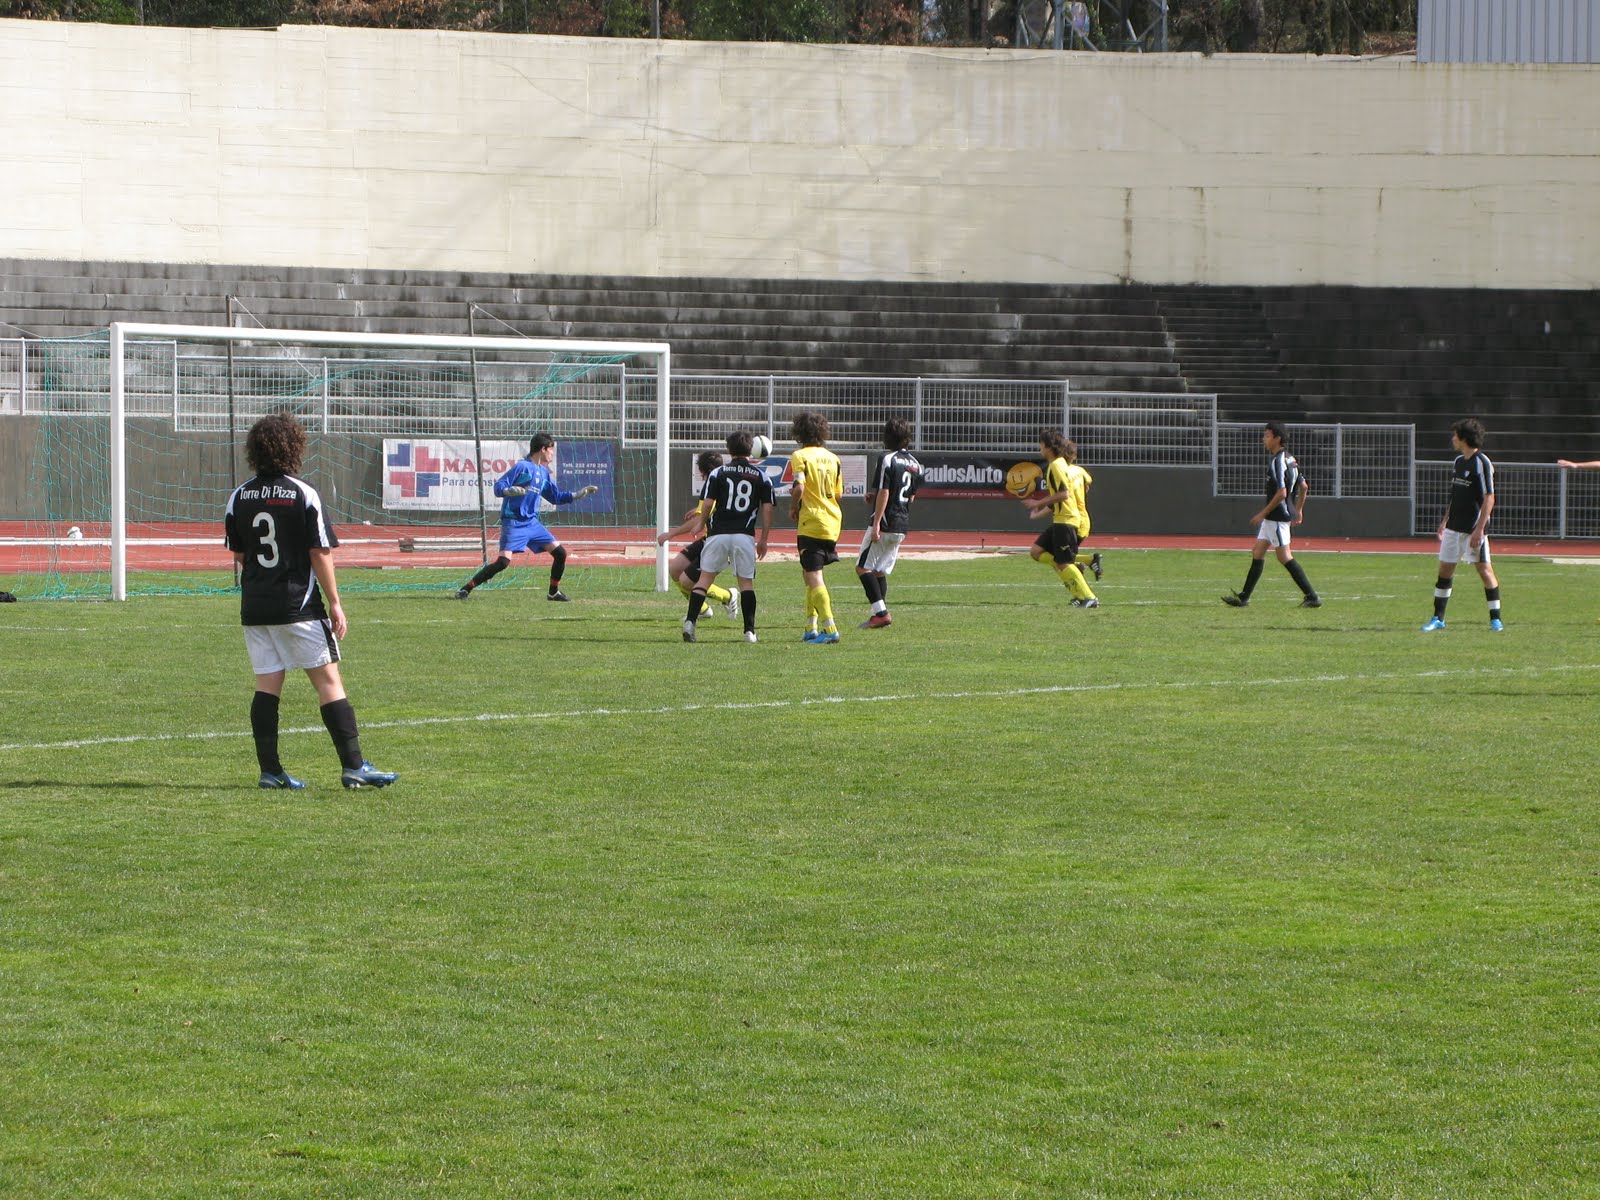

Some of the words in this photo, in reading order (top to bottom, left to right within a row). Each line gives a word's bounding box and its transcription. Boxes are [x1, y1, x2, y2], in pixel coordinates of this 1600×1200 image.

[240, 487, 260, 500] Torre
[261, 486, 271, 499] Di
[272, 485, 297, 500] Pizza
[442, 477, 465, 487] Para
[843, 485, 864, 494] obil
[899, 471, 912, 502] 2
[725, 476, 753, 512] 18
[252, 511, 280, 569] 3
